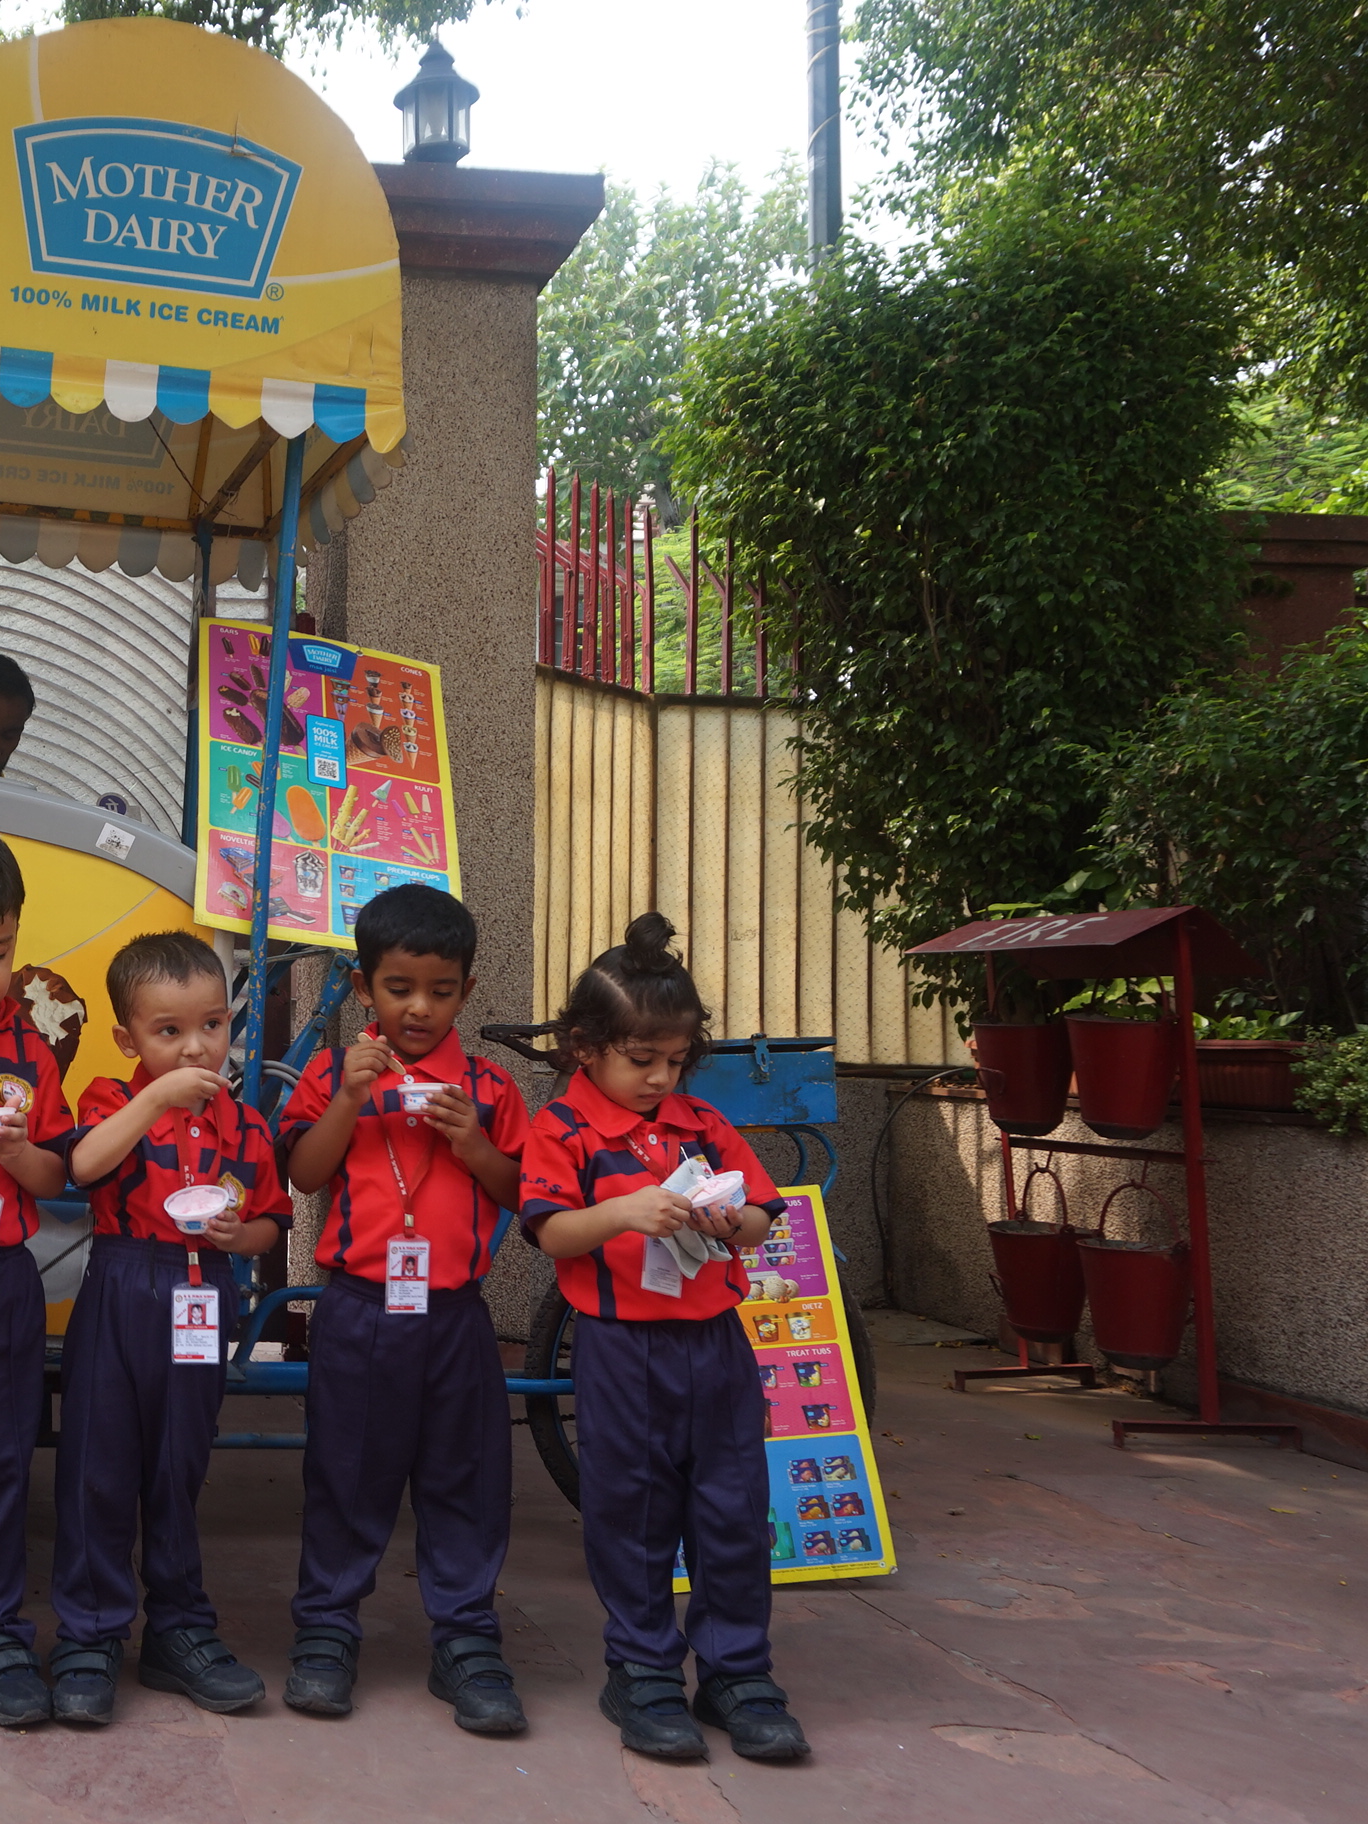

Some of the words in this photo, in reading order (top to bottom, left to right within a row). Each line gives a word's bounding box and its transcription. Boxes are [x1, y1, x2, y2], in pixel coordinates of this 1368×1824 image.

[45, 156, 264, 229] MOTHER
[83, 208, 228, 259] DAIRY
[10, 286, 72, 309] 100%
[81, 293, 142, 317] MILK
[149, 302, 189, 323] ICE
[197, 308, 280, 334] CREAM
[219, 627, 239, 636] BARS
[307, 649, 338, 660] MOTHER
[400, 666, 423, 677] CONES
[312, 727, 338, 738] 100%
[314, 734, 338, 746] MILK
[232, 747, 258, 757] CANDY
[414, 785, 433, 793] KULFI
[386, 866, 421, 878] PREMIUM
[421, 872, 441, 881] CUPS
[956, 916, 1110, 948] FIRE
[801, 1302, 824, 1310] DIETZ
[785, 1349, 810, 1357] TREAT
